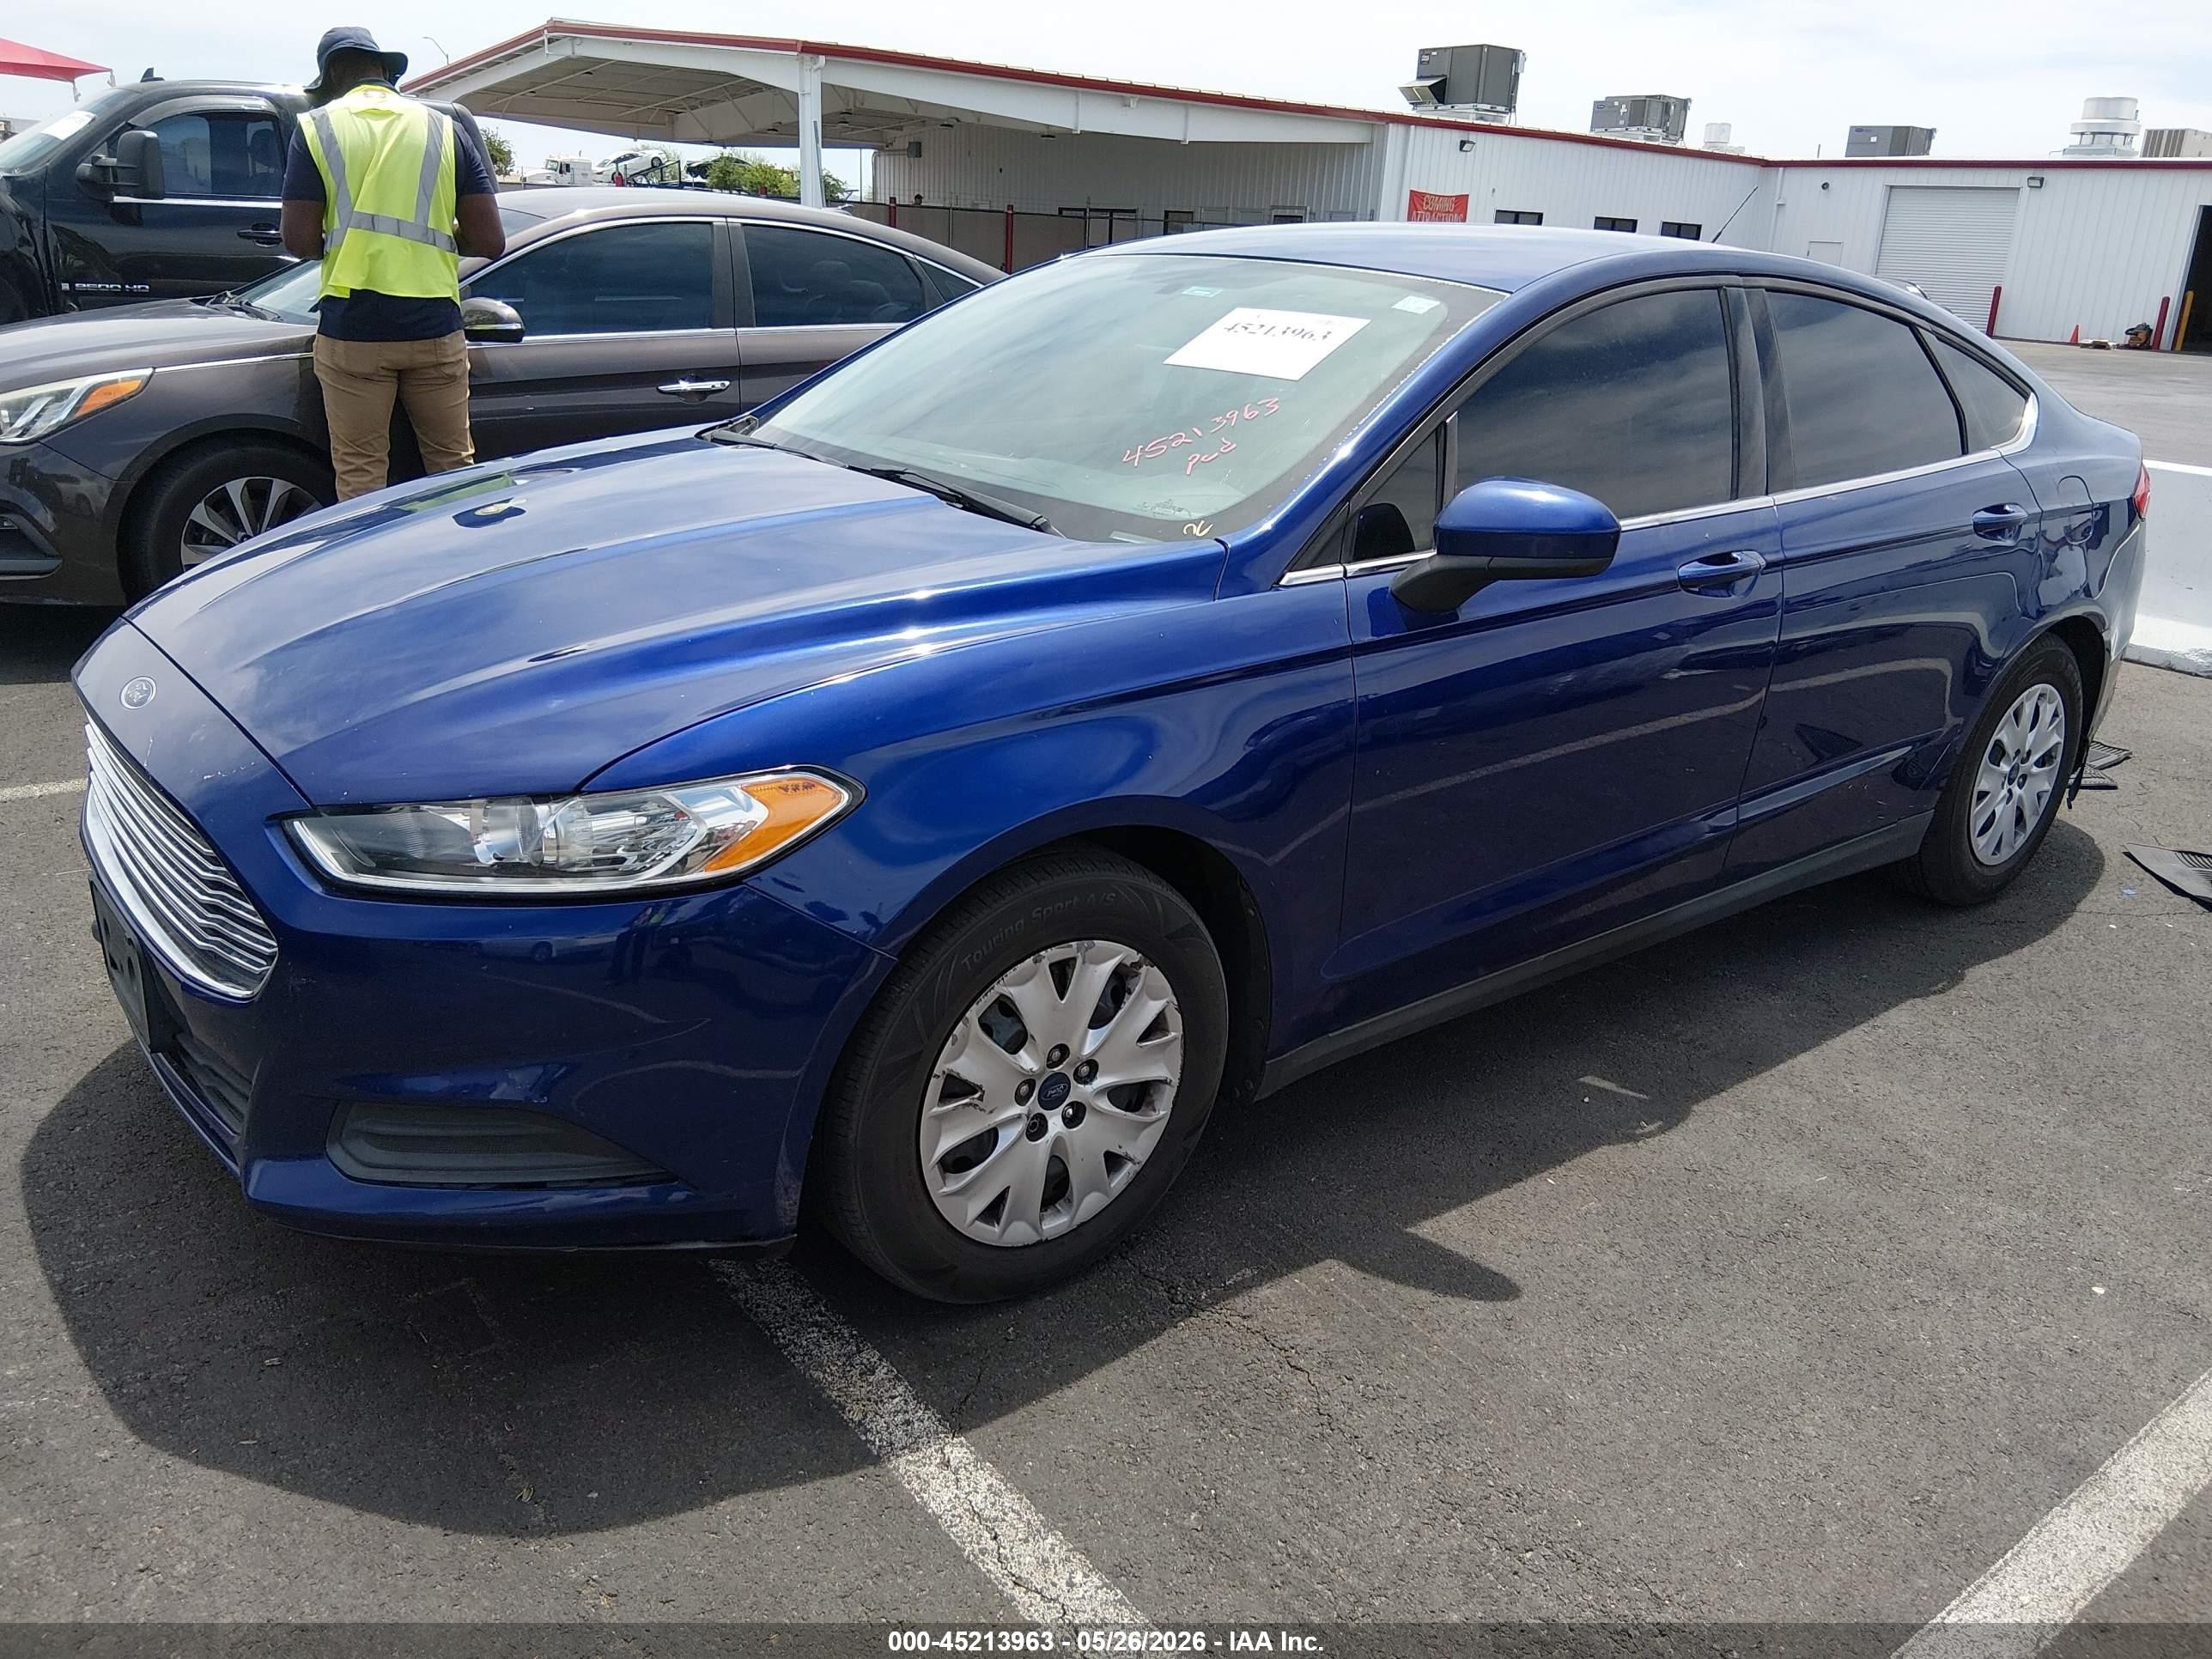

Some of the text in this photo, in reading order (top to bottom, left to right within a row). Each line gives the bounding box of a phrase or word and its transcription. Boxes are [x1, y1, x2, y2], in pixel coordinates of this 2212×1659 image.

[1423, 195, 1456, 211] COMING
[1224, 322, 1332, 342] 45213963
[1122, 398, 1279, 467] 45213963
[961, 919, 1024, 970] Touring
[1031, 897, 1079, 921] Sport
